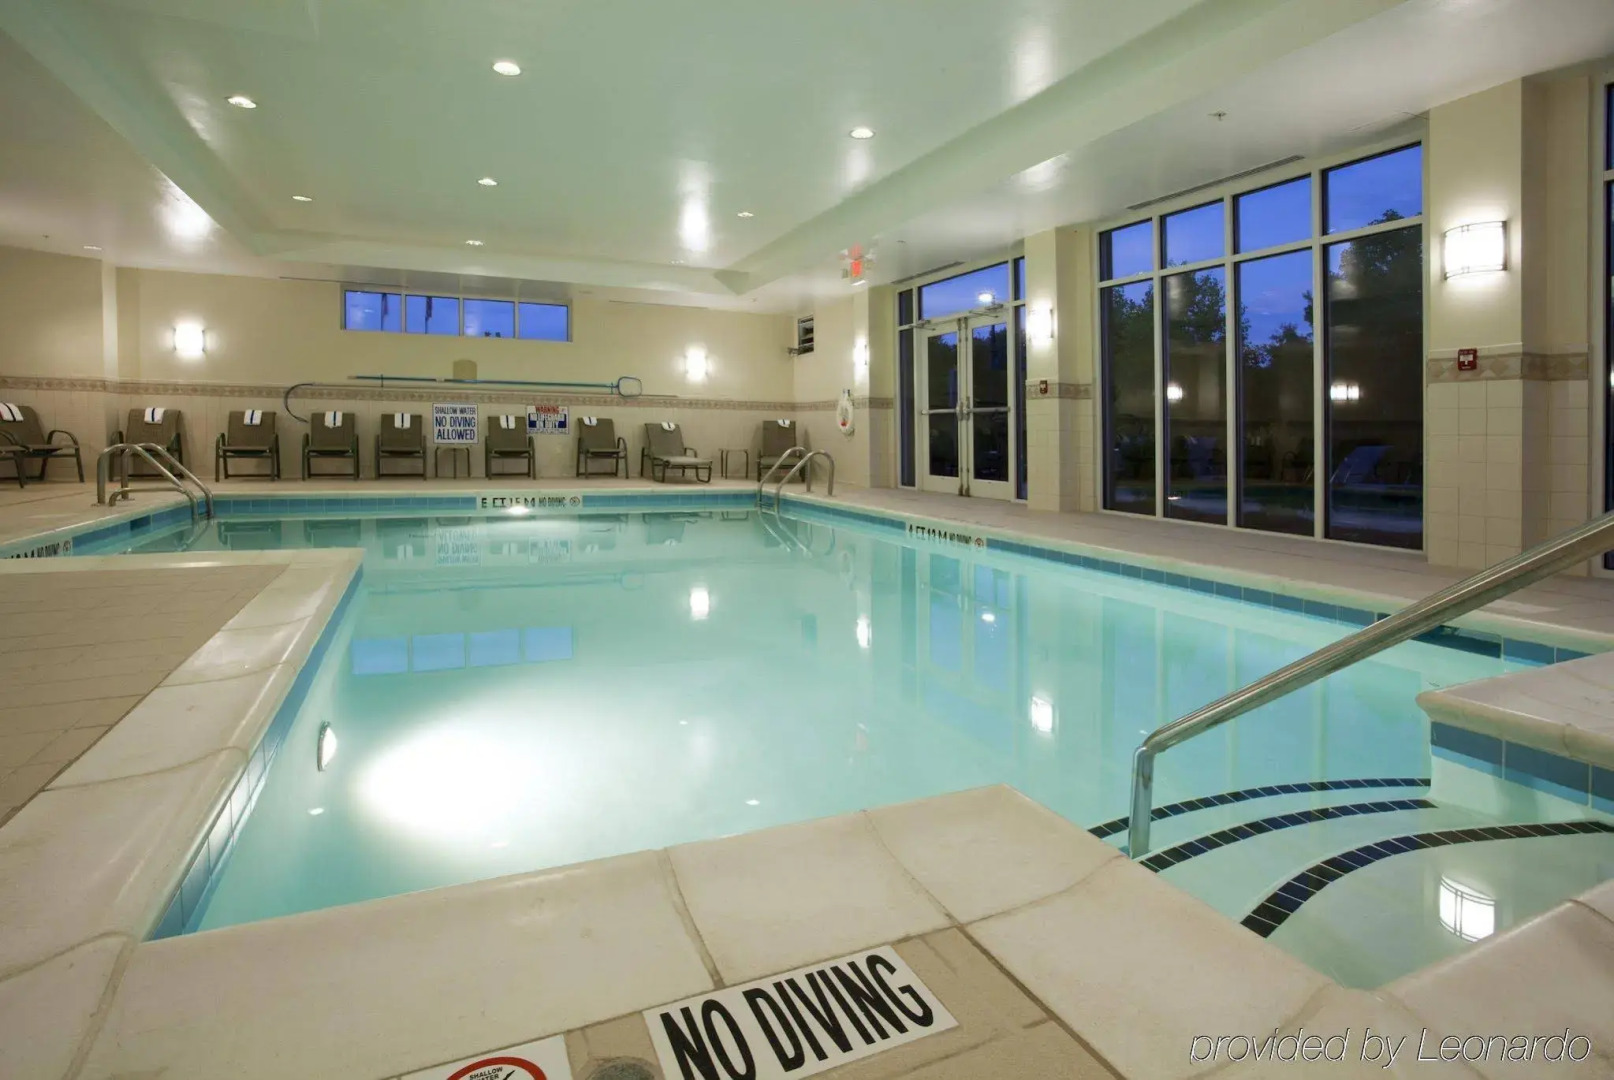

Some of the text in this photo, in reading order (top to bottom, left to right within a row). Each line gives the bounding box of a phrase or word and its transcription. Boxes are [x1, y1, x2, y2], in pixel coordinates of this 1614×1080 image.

[435, 406, 476, 415] SHALLOW WATER
[435, 416, 475, 427] NO DIVING
[436, 428, 475, 440] ALLOWED
[660, 954, 934, 1080] NO DIVING
[470, 1066, 503, 1079] SHALLOW
